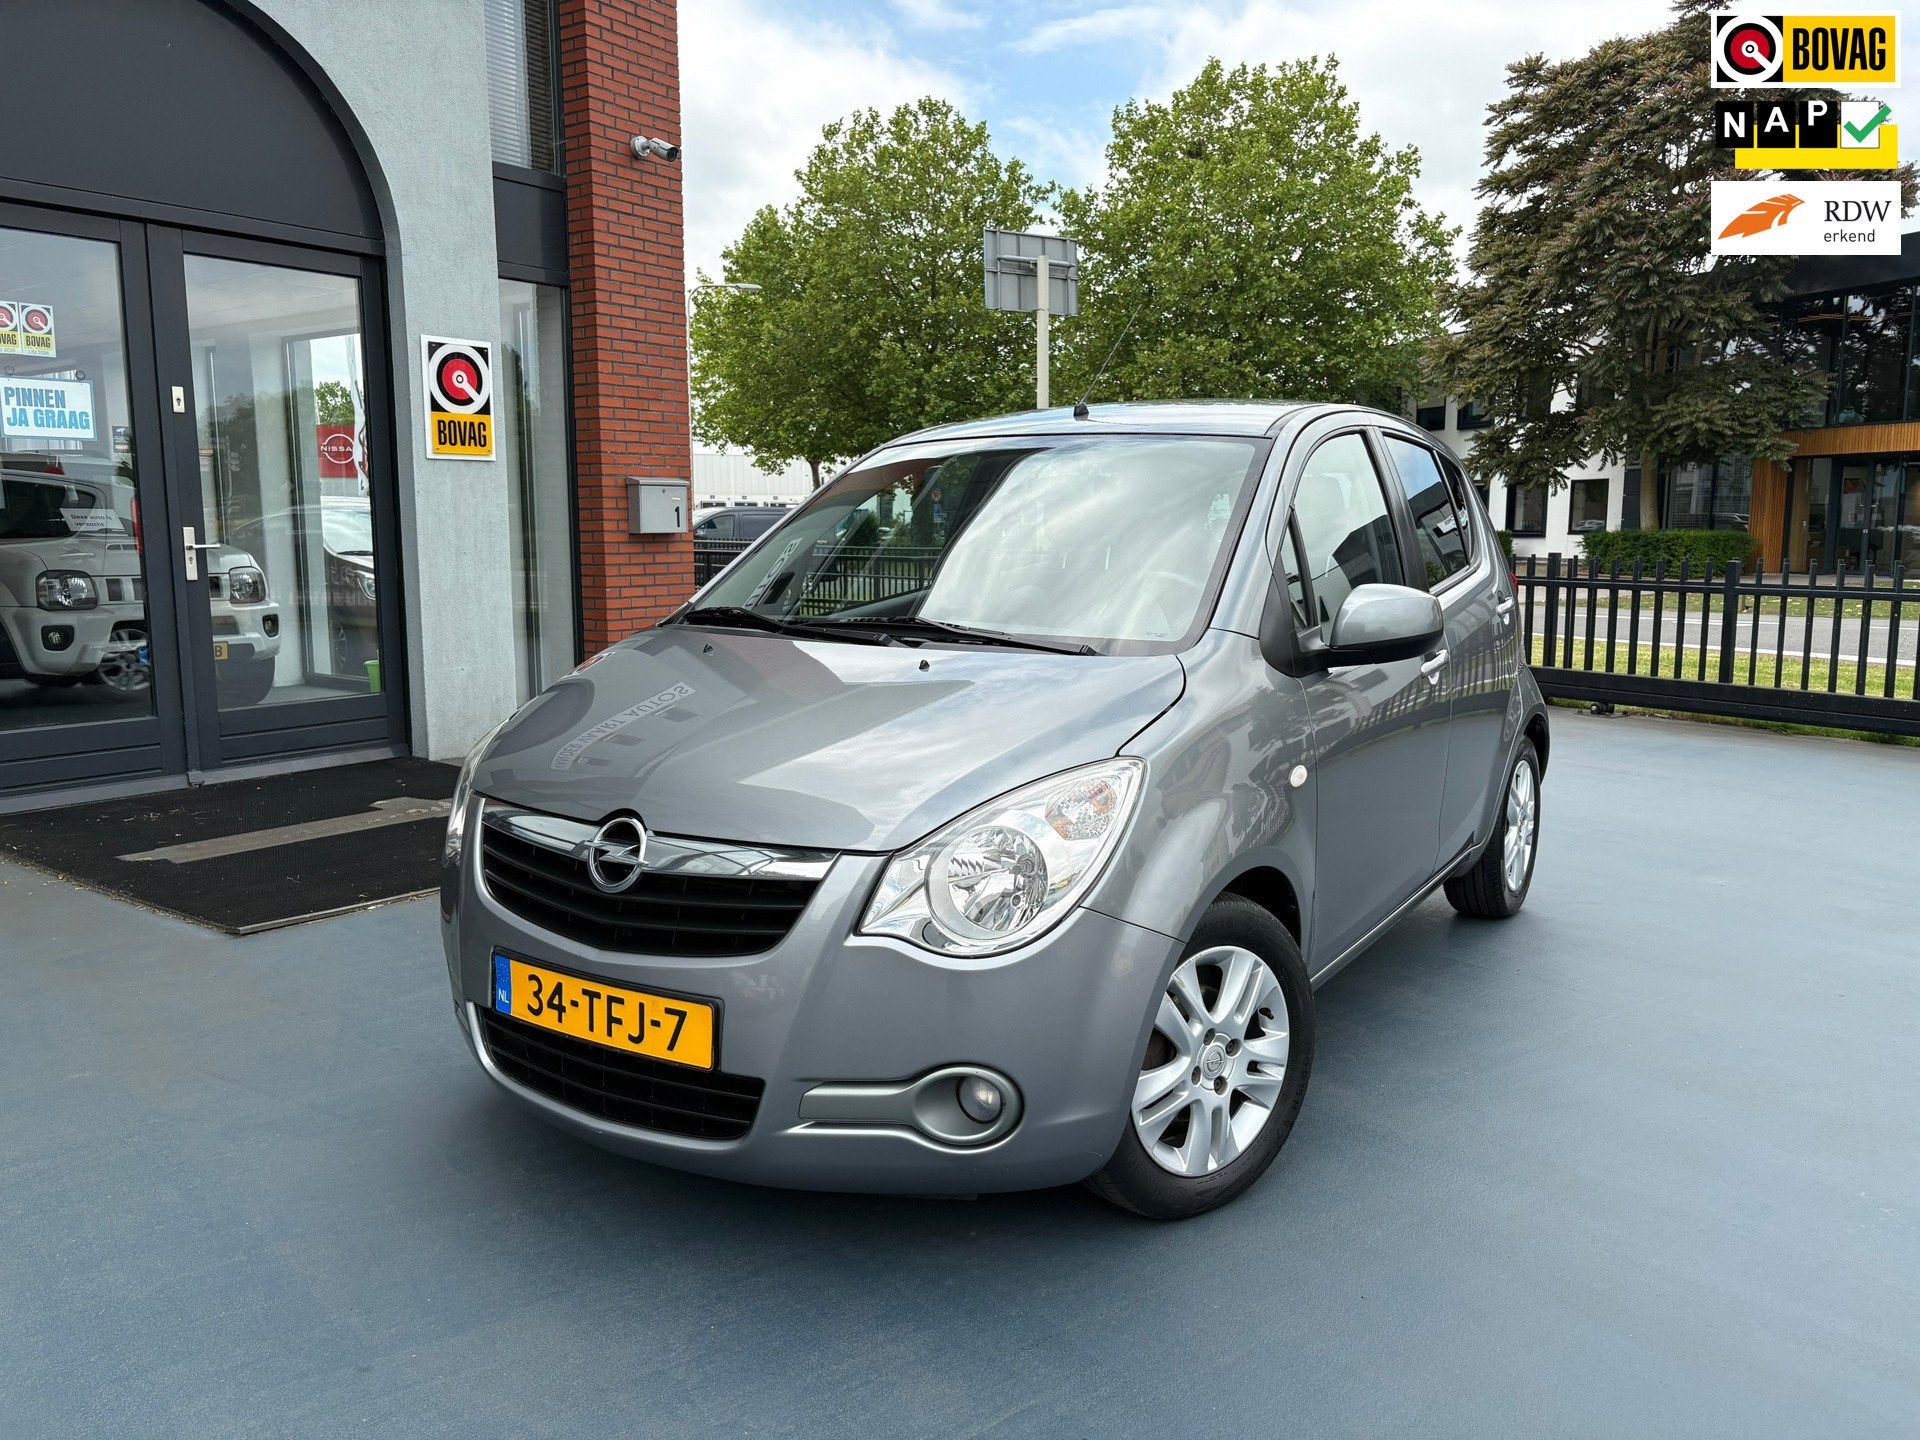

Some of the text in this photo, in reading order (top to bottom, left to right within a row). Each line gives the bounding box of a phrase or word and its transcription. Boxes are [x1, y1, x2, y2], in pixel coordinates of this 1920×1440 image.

[0, 333, 17, 345] VAG
[26, 335, 51, 348] BOVAG
[4, 386, 67, 409] PINNEN
[6, 407, 91, 430] JA GRAAG
[437, 419, 487, 448] BOVAG
[674, 506, 680, 528] 1
[498, 988, 510, 1004] NL
[527, 973, 688, 1051] 34-TFJ-7
